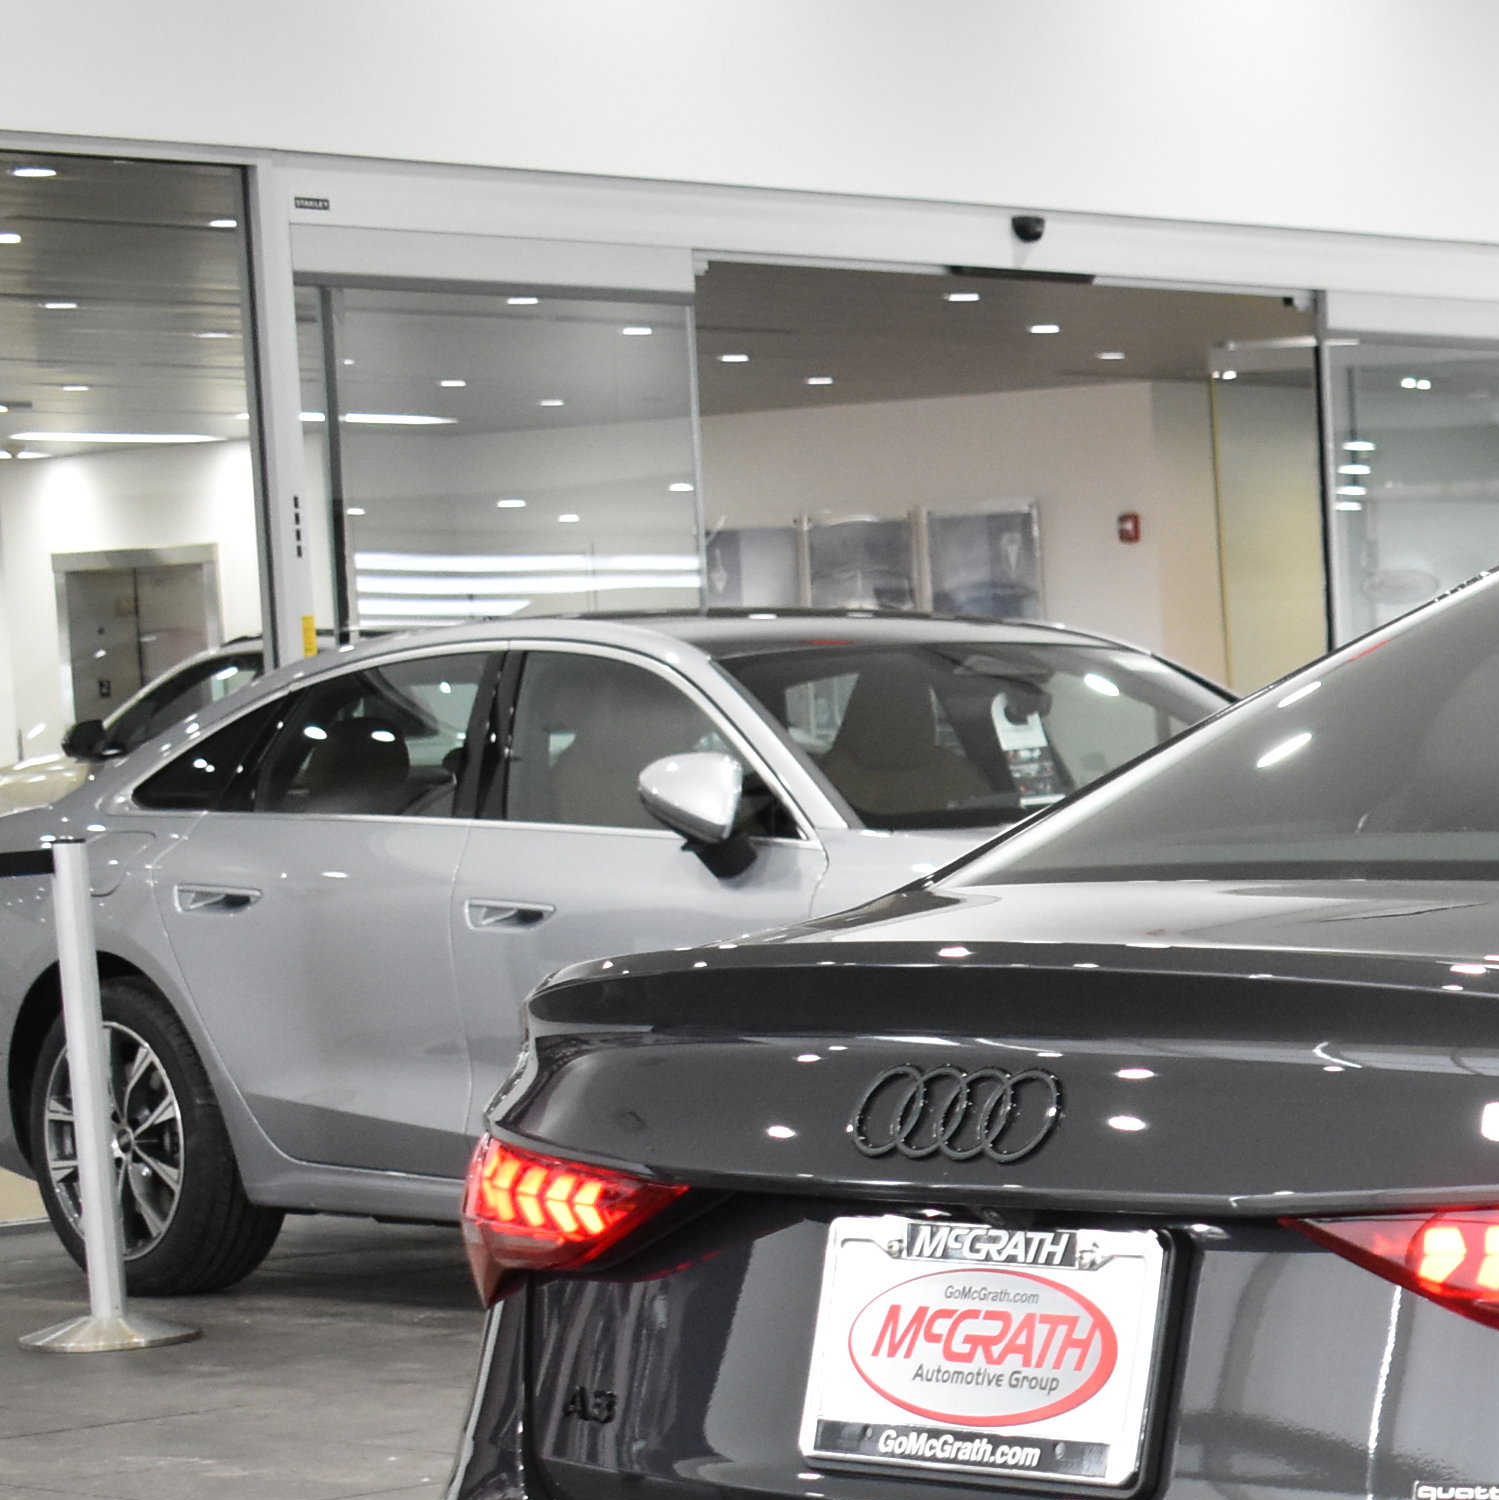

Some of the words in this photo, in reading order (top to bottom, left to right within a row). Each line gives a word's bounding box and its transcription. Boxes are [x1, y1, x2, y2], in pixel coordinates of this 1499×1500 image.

[944, 1284, 1039, 1304] GoMcGrath.com
[912, 1363, 1004, 1388] Automotive
[1008, 1374, 1060, 1395] Group
[564, 1385, 617, 1424] A3
[877, 1428, 1041, 1468] GoMcGrath.com
